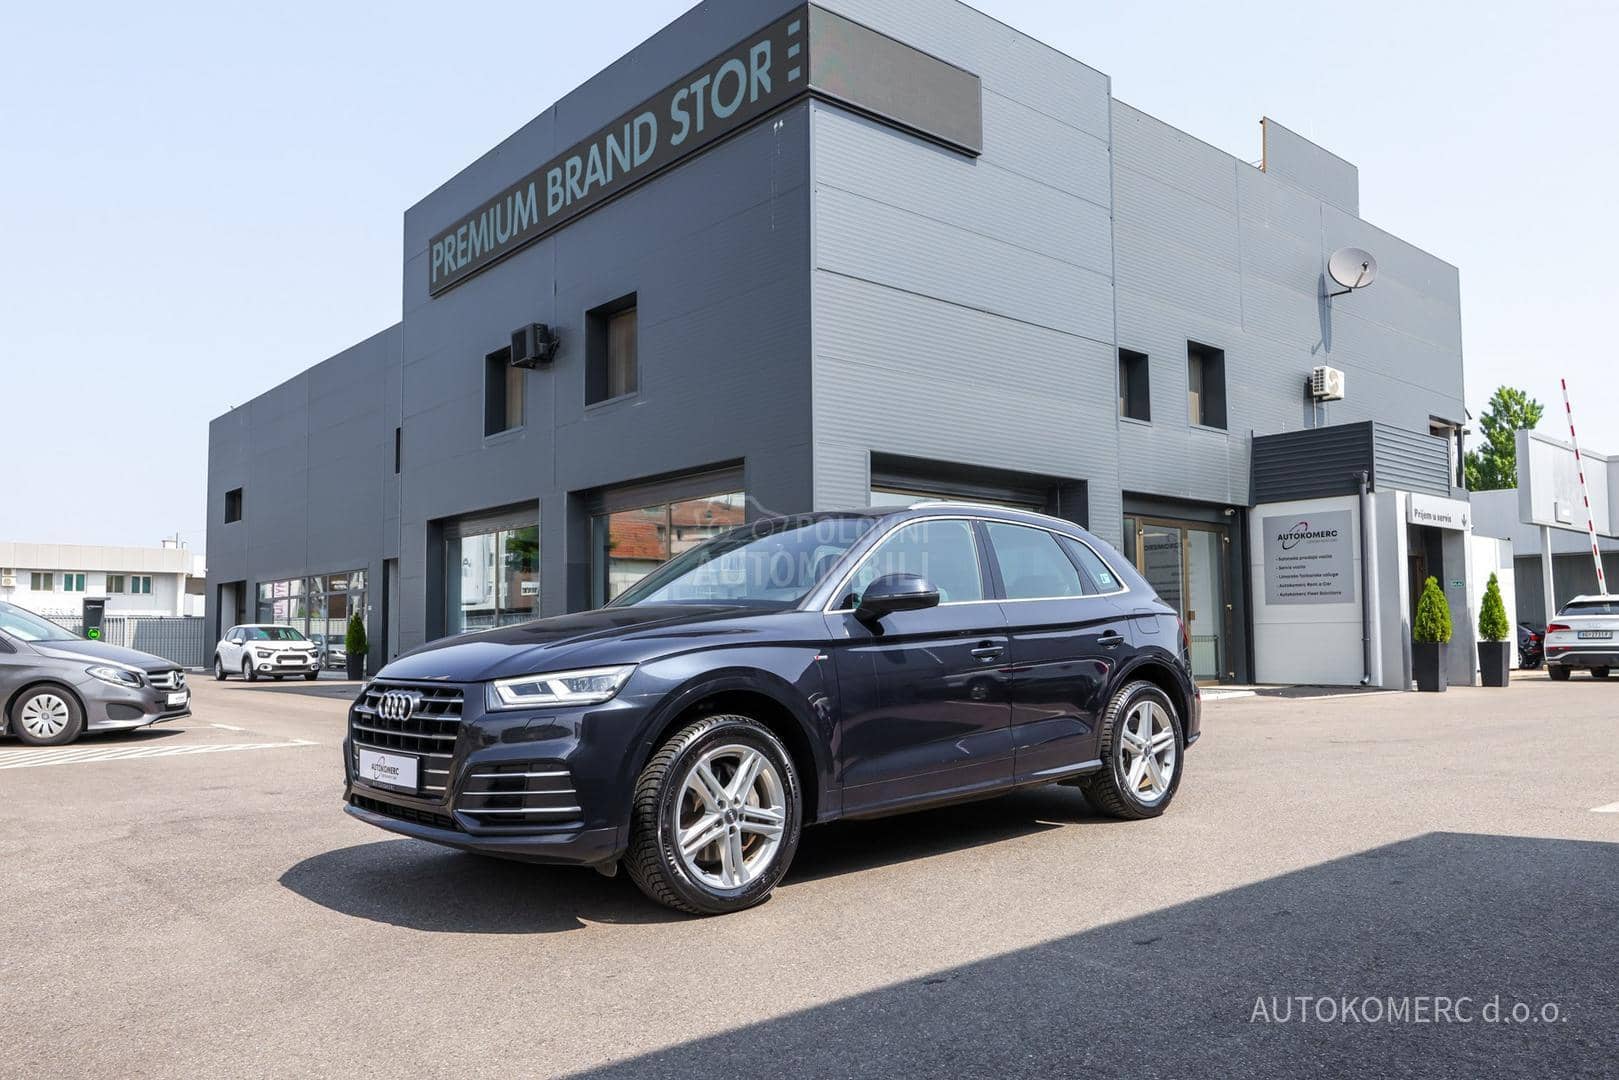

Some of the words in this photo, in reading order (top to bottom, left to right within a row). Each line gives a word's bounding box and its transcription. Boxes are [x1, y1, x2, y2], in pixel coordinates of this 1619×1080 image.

[432, 182, 539, 283] PREMIUM
[546, 111, 659, 217] BRAND
[1414, 508, 1432, 521] Prijem
[1437, 513, 1452, 523] servis
[1277, 530, 1338, 541] AUTOKOMERC
